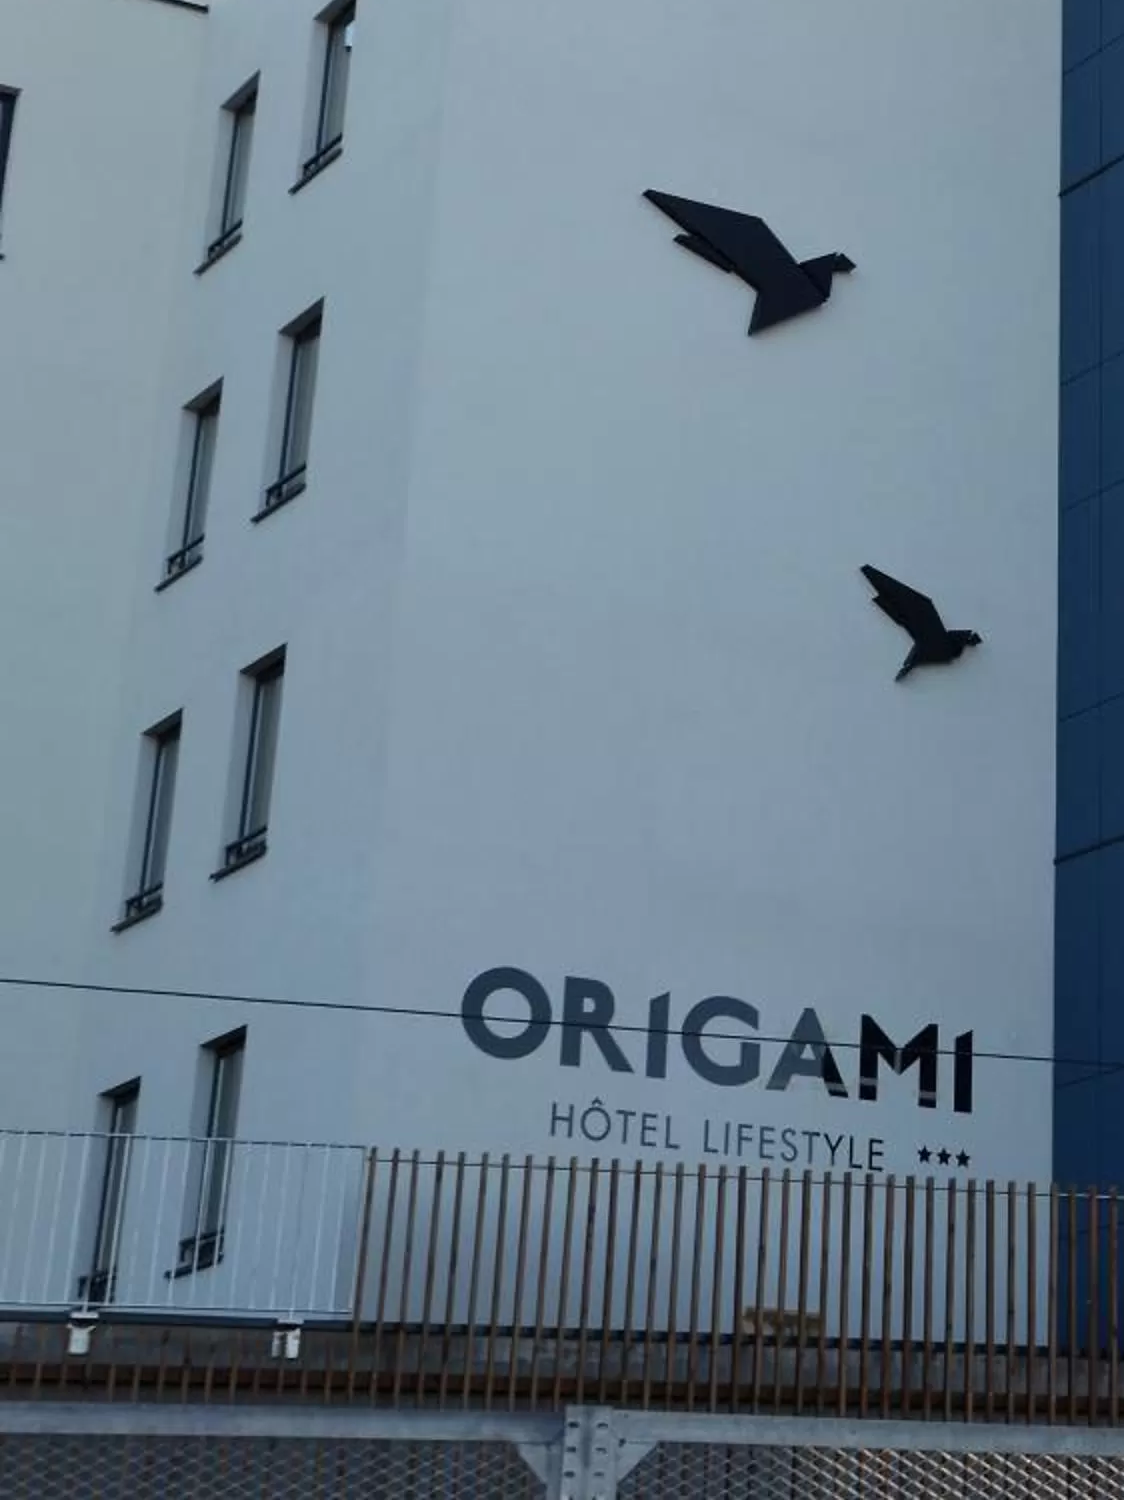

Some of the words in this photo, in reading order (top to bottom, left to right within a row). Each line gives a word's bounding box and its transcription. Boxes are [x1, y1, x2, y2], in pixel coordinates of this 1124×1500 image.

[461, 966, 974, 1113] ORIGAMI
[550, 1097, 681, 1151] HÔTEL
[703, 1118, 885, 1171] LIFESTYLE
